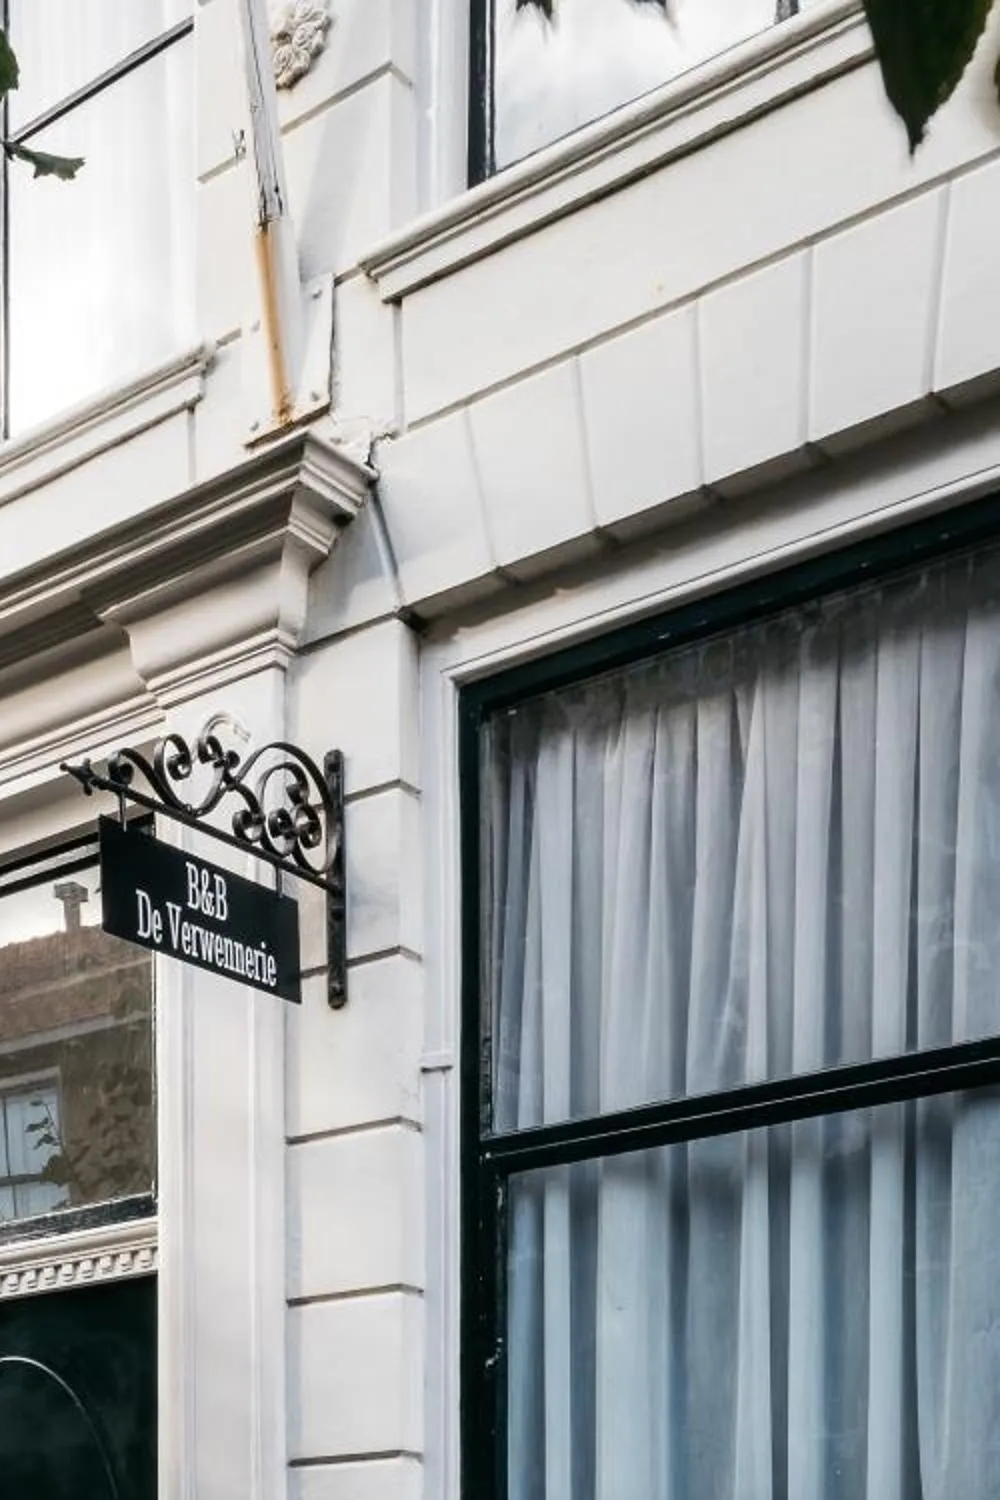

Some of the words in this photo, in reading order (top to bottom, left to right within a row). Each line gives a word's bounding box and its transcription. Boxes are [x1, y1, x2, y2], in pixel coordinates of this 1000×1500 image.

[185, 861, 228, 921] B&B
[135, 888, 163, 944] De
[165, 901, 277, 987] Verwennerie
